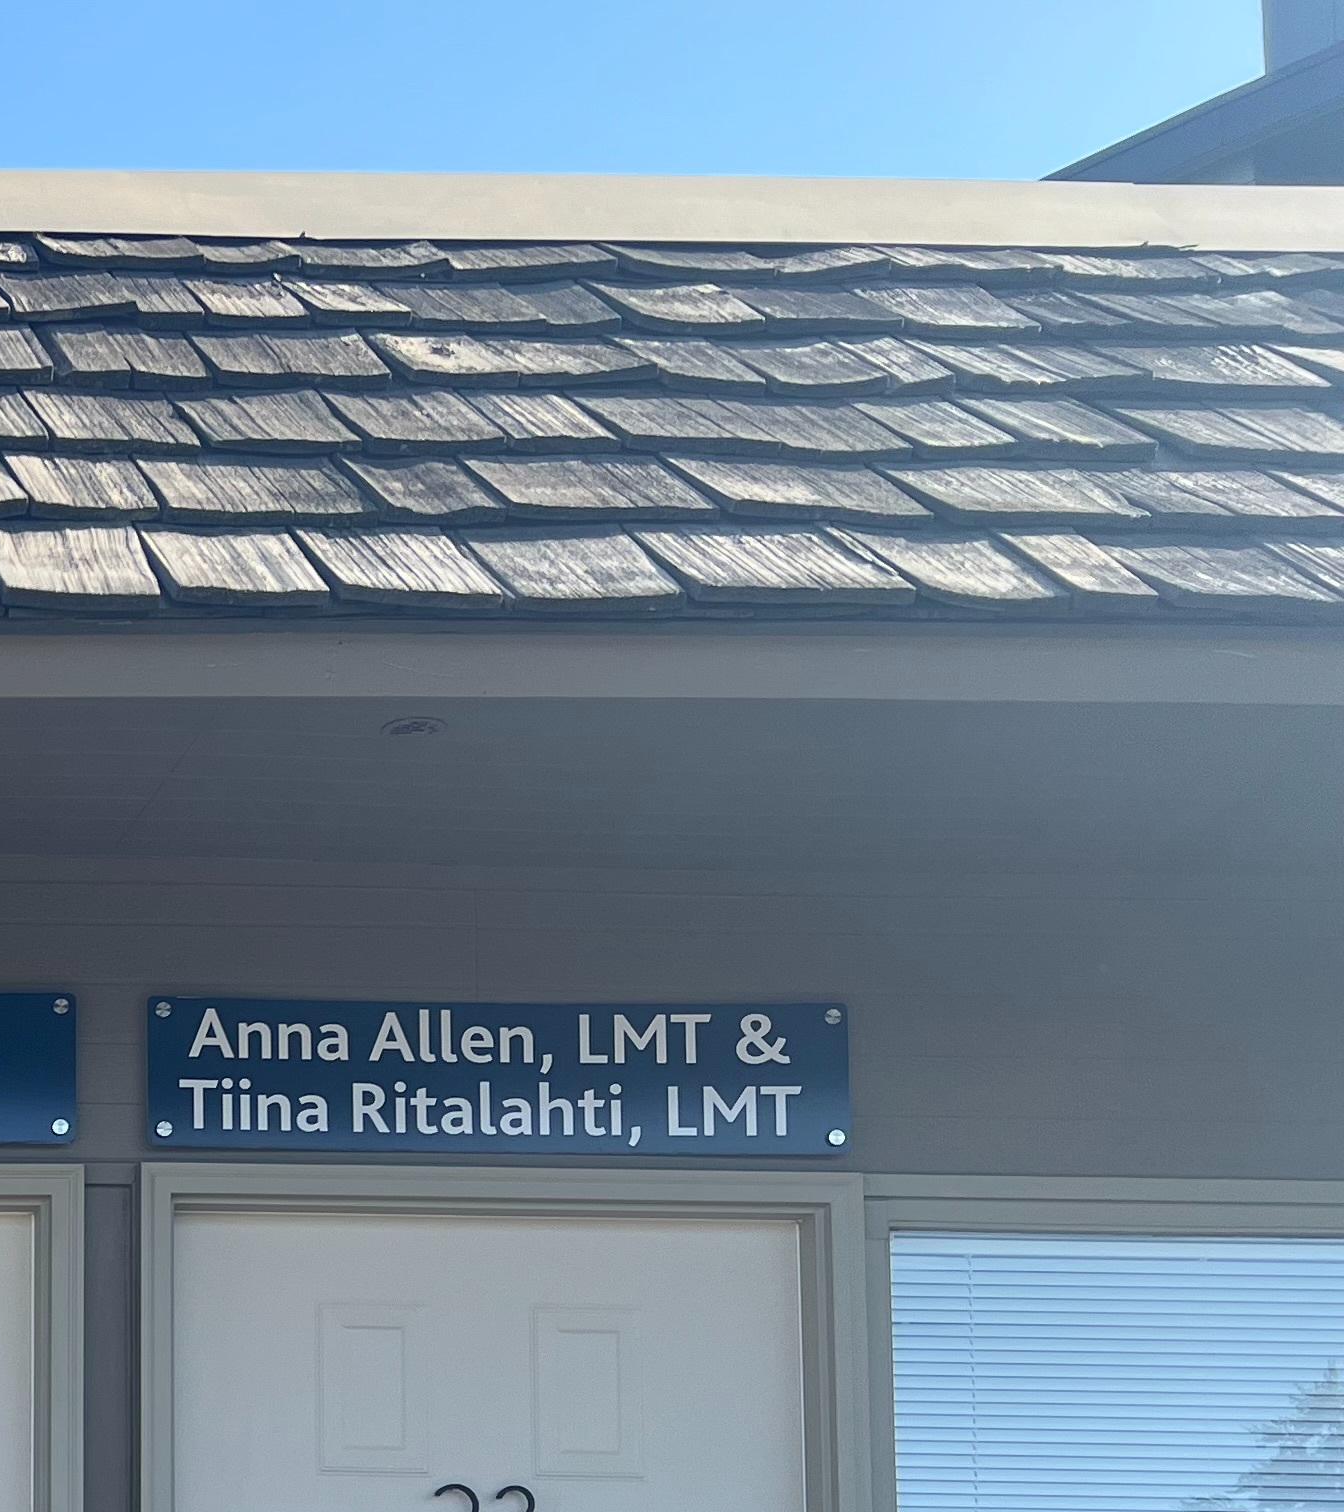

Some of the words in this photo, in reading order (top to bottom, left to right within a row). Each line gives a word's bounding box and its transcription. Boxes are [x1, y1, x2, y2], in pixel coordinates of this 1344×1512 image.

[188, 1007, 349, 1061] Anna
[368, 1009, 553, 1074] Allen,
[578, 1014, 712, 1064] LMT
[735, 1013, 791, 1065] &
[178, 1077, 329, 1132] Tiina
[352, 1081, 642, 1147] Ritalahti,
[667, 1085, 802, 1136] LMT
